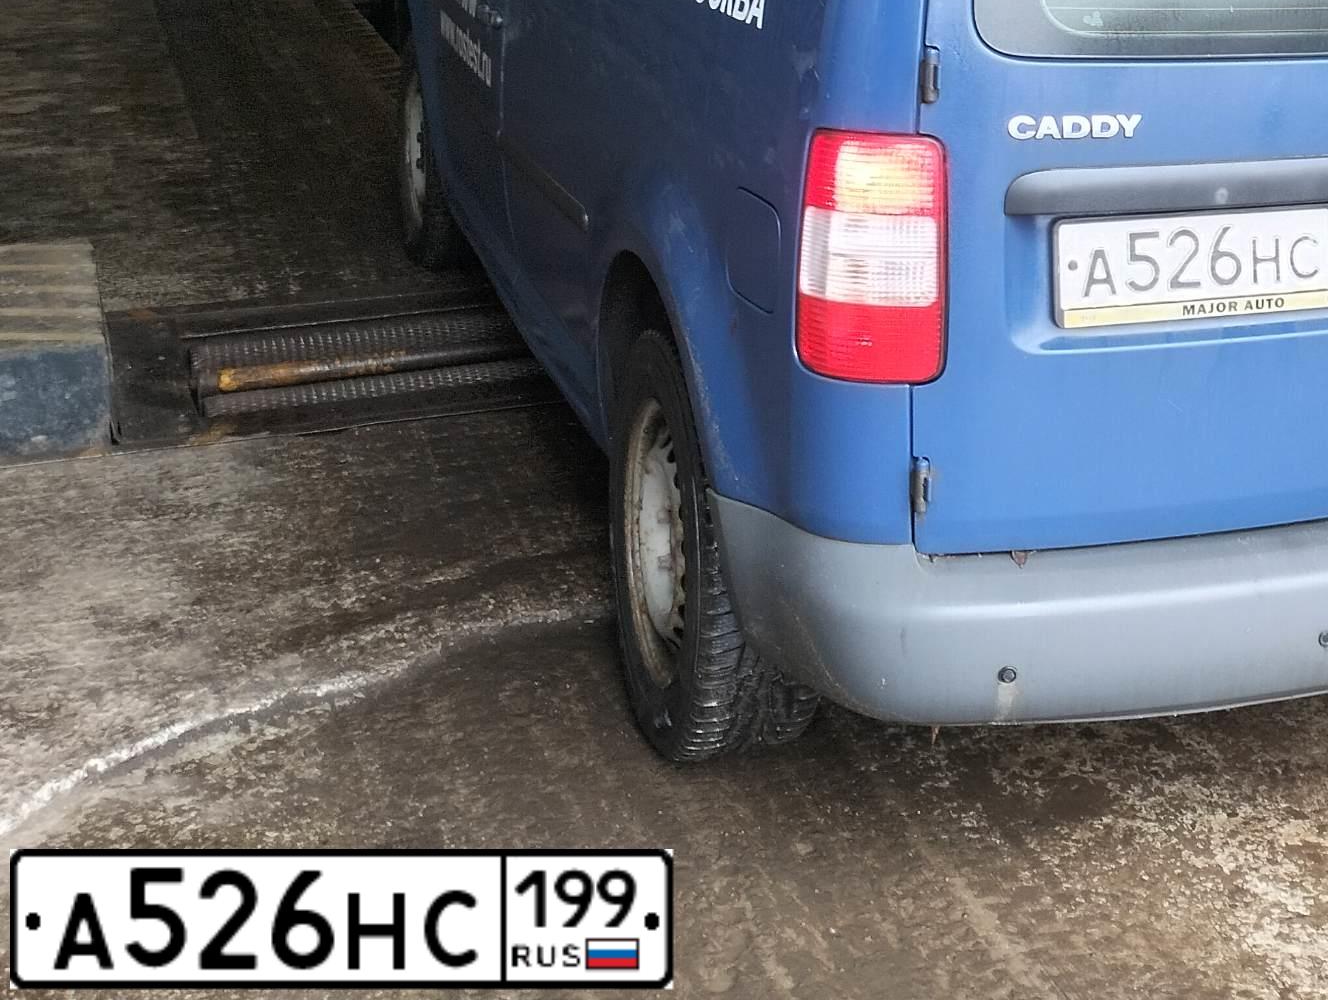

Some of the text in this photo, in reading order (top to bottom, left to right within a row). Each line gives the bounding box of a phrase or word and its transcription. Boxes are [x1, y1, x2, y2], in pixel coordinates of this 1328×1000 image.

[1007, 114, 1142, 140] CADDY
[1182, 301, 1239, 316] MAJOR
[1244, 297, 1285, 311] AUTO
